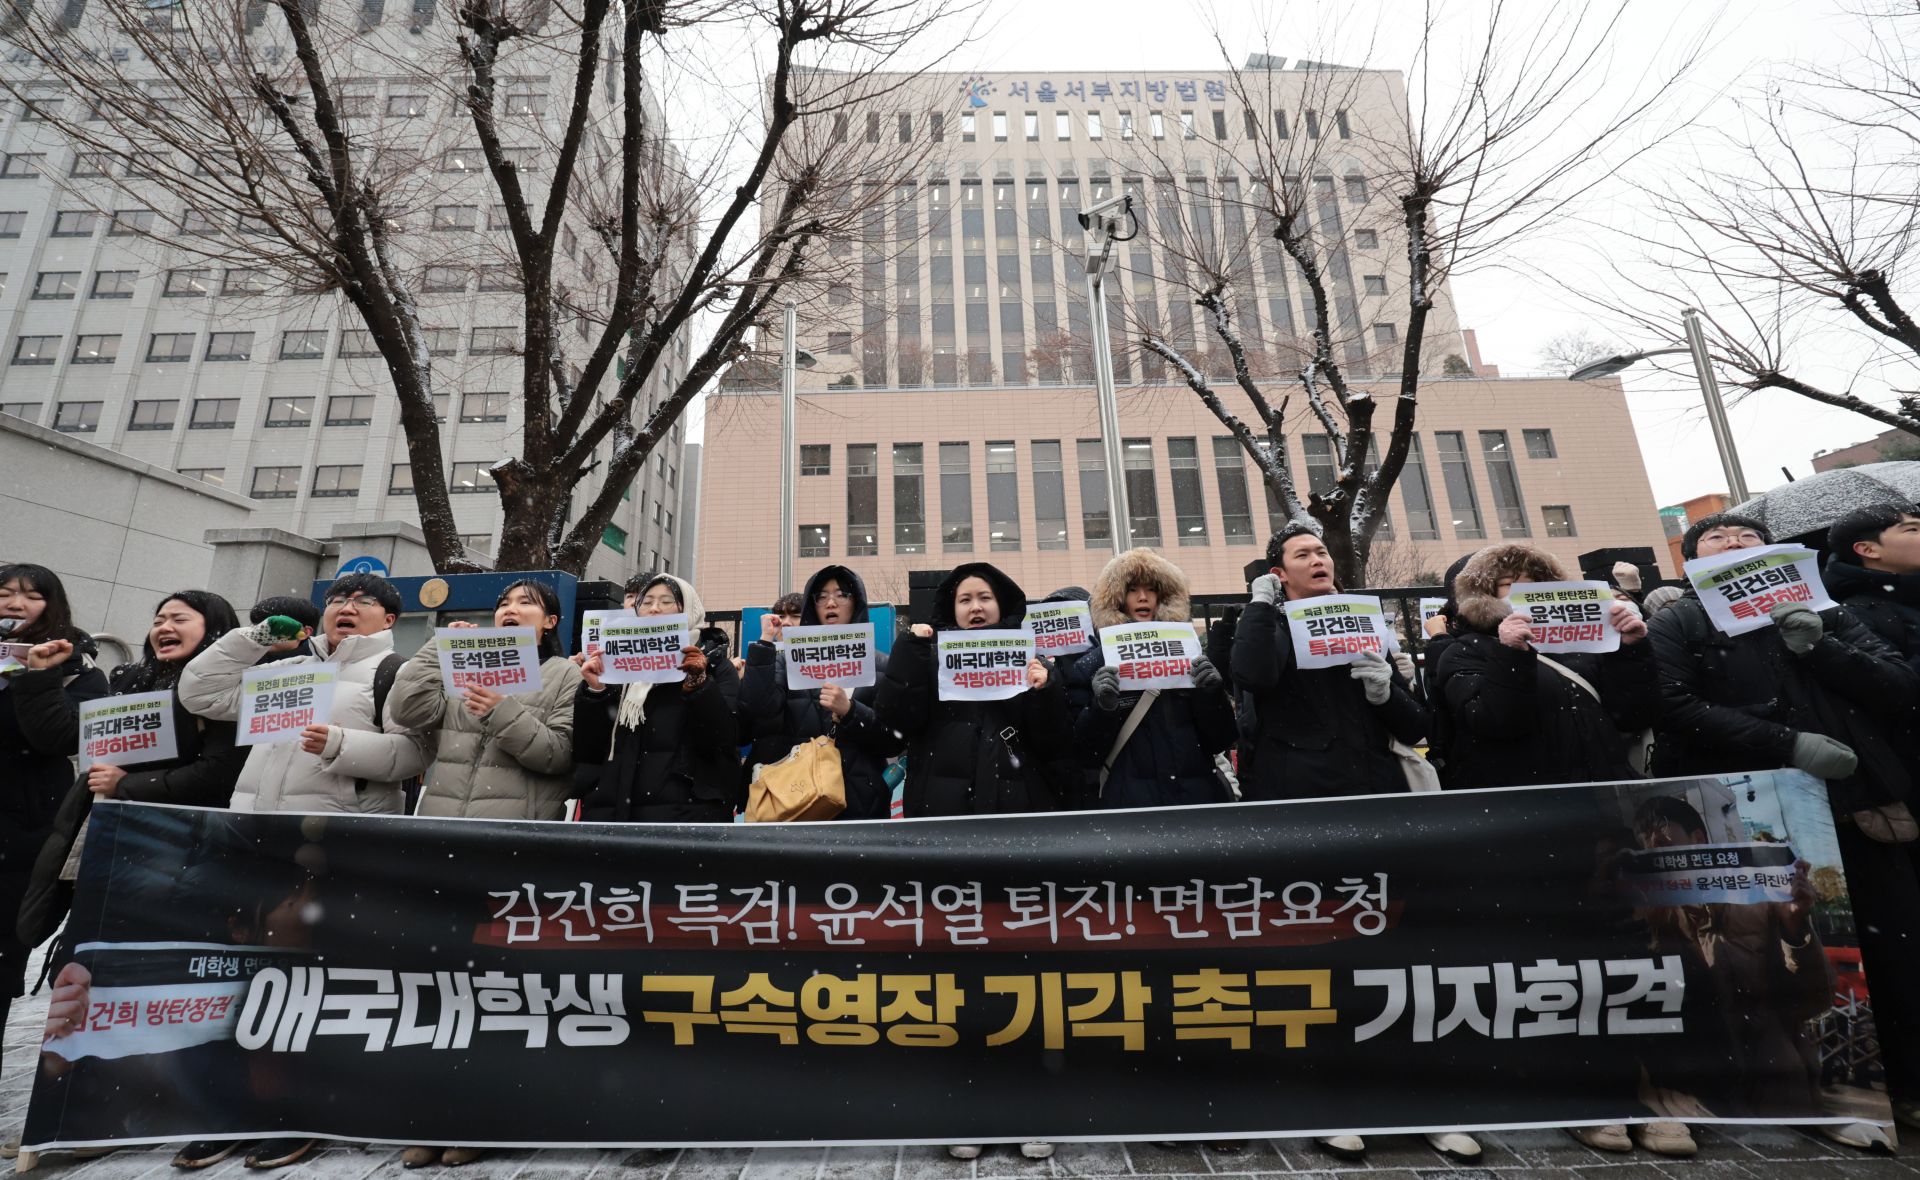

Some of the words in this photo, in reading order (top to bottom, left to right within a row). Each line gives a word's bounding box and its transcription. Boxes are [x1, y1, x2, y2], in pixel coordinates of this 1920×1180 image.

[1008, 80, 1226, 103] 서울서부지방법원
[1735, 559, 1768, 576] 범죄자
[1718, 564, 1802, 602] 김건희를
[1524, 592, 1555, 603] 김건희
[1557, 589, 1599, 601] 방탄정권
[1043, 609, 1061, 617] 범죄자
[1304, 606, 1323, 616] 특급
[1324, 604, 1350, 614] 범죄자
[1530, 603, 1602, 624] 윤석열은
[1032, 616, 1081, 634] 김건희를
[1306, 615, 1375, 637] 김건희를
[1530, 624, 1604, 644] 퇴진하라!
[450, 639, 475, 649] 김건희
[478, 637, 517, 648] 방탄정권
[605, 635, 680, 655] 애국대학생
[1034, 630, 1086, 648] 특검하라!
[1115, 633, 1132, 642] 특급
[1134, 630, 1158, 640] 범죄자
[1309, 635, 1382, 656] 특검하라!
[451, 649, 520, 670] 윤석열은
[791, 643, 866, 663] 애국대학생
[945, 651, 1027, 669] 애국대학생
[1117, 640, 1185, 661] 김건희를
[613, 654, 677, 671] 석방하라!
[800, 661, 862, 680] 석방하라!
[1119, 658, 1191, 680] 특검하라!
[257, 679, 280, 691] 김건희
[282, 673, 315, 688] 방탄정권
[452, 667, 527, 688] 퇴진하라!
[953, 669, 1023, 688] 석방하라!
[254, 687, 314, 713] 윤석열은
[84, 712, 161, 740] 애국대학생
[249, 708, 314, 734] 퇴진하라!
[86, 731, 157, 757] 석방하라!
[1690, 853, 1713, 867] 면담
[1716, 852, 1739, 866] 요청
[1696, 874, 1750, 891] 윤석열은
[488, 881, 655, 944] 김건희
[667, 880, 797, 946] 특검!
[810, 881, 989, 946] 윤석열
[1003, 880, 1136, 944] 퇴진!
[188, 956, 239, 978] 대학생
[146, 995, 234, 1026] 방탄정권
[235, 967, 630, 1052] 애국대학생
[642, 971, 965, 1047] 구속영장
[984, 970, 1152, 1051] 기각
[1172, 967, 1338, 1050] 촉구
[1354, 954, 1685, 1043] 기자회견
